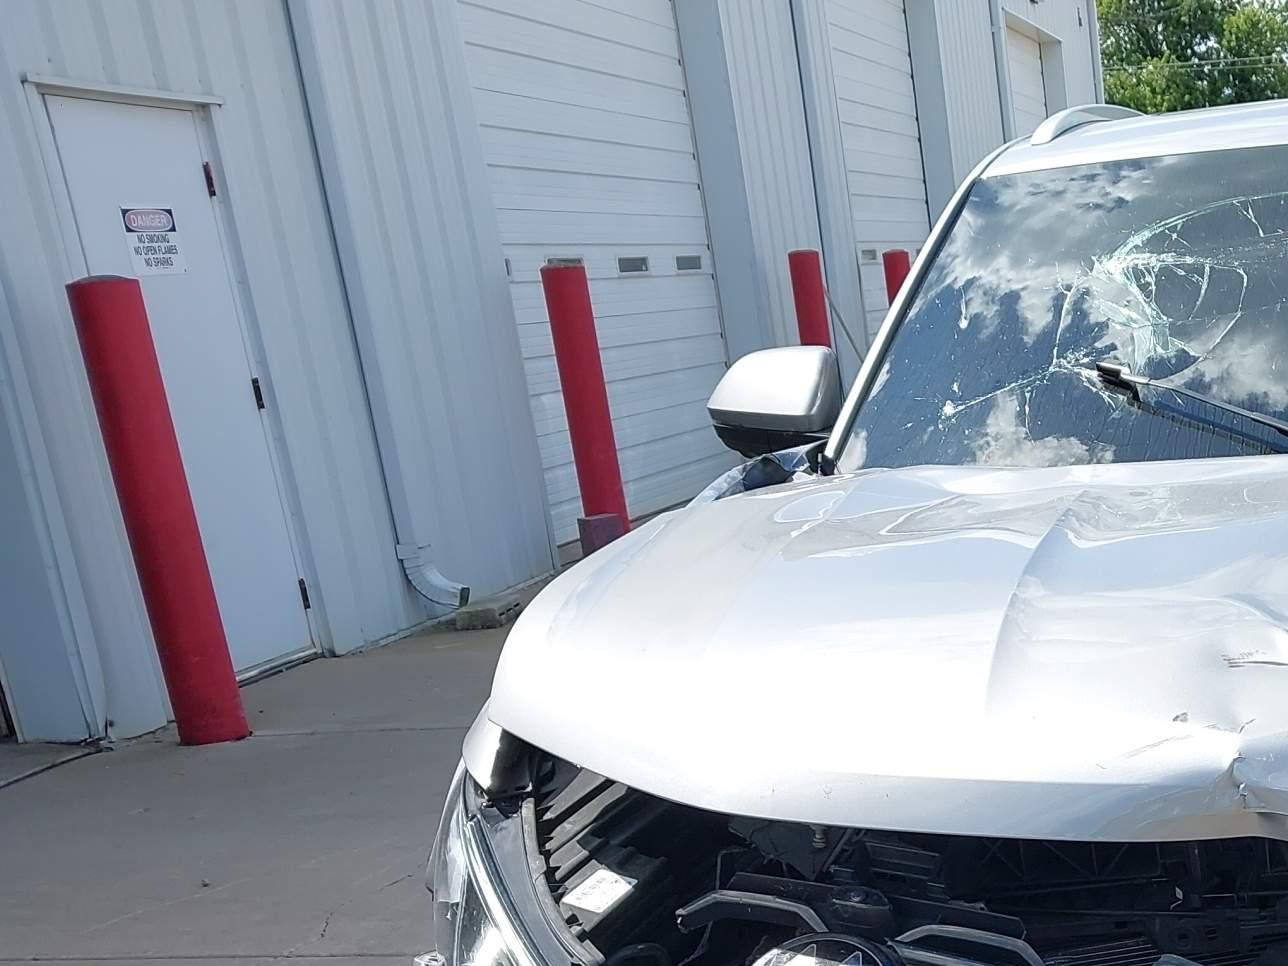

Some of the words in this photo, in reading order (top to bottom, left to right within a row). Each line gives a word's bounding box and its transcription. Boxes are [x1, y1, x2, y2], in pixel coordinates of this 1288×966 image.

[129, 214, 168, 227] DANGER
[136, 233, 146, 244] NO
[145, 233, 170, 244] SMOKING
[133, 245, 143, 256] NO
[142, 245, 158, 256] OPEN
[158, 244, 178, 255] FLAMES
[143, 257, 153, 267] NO
[152, 256, 174, 267] SPARKS
